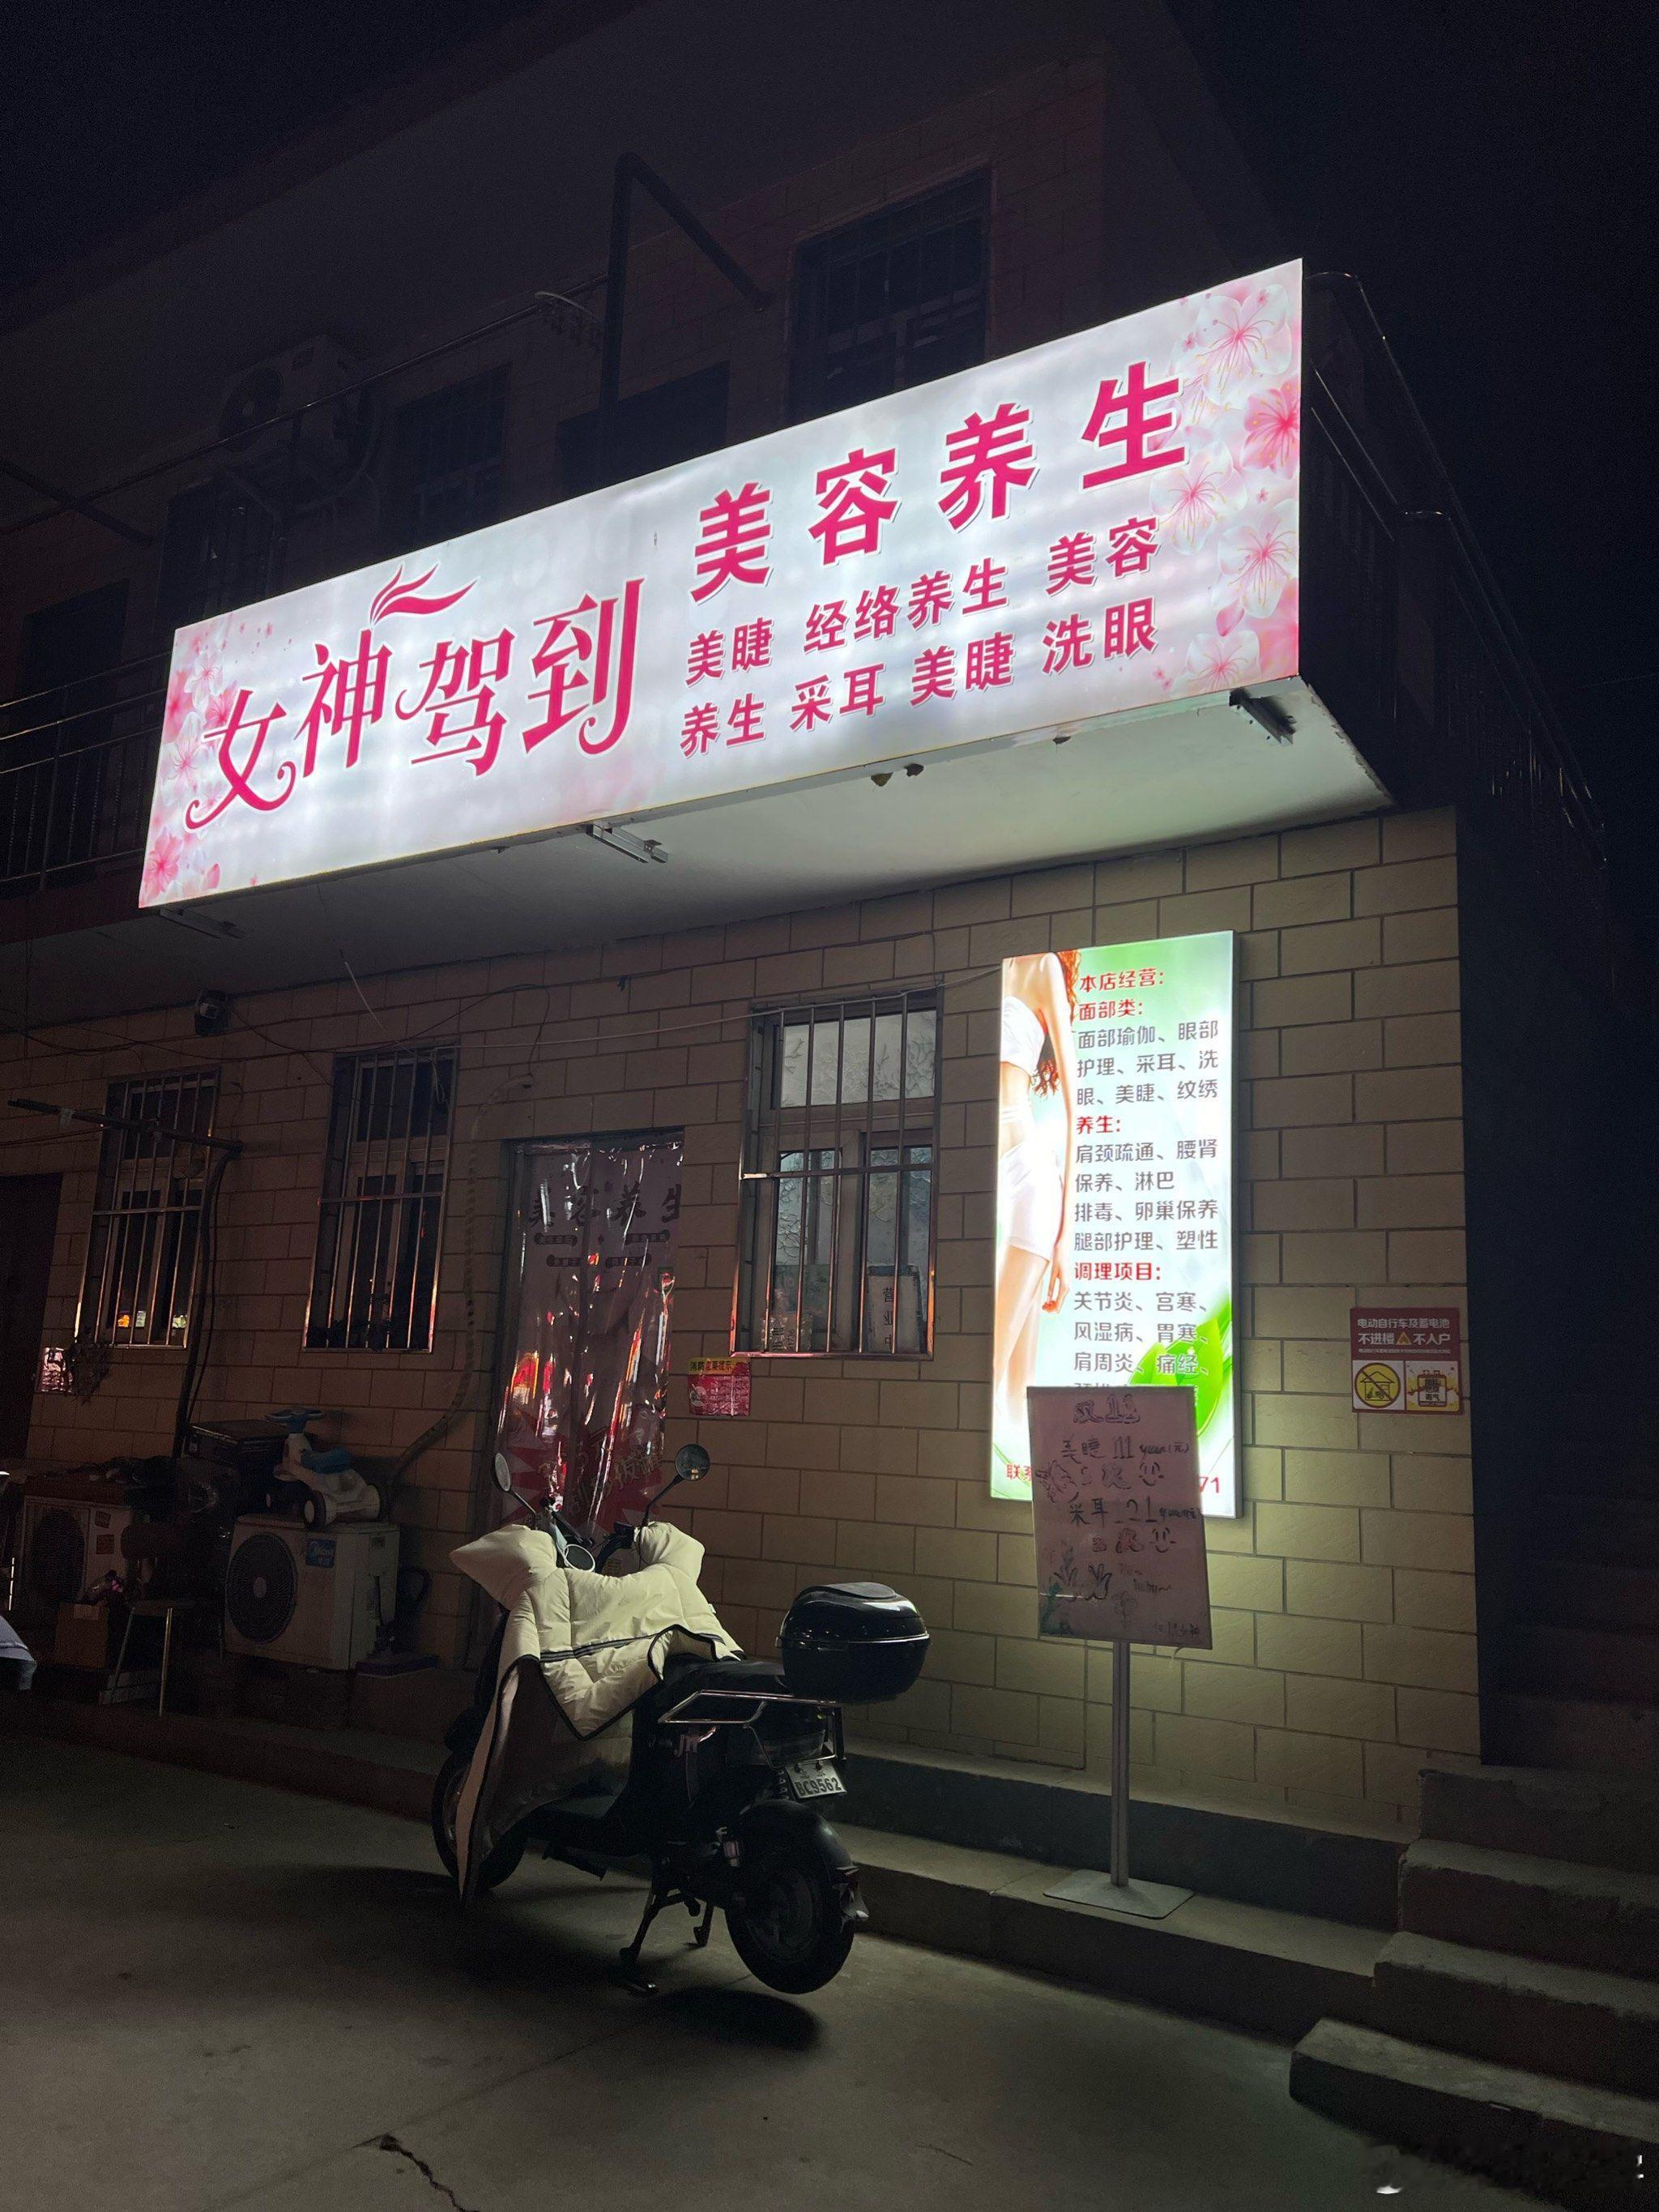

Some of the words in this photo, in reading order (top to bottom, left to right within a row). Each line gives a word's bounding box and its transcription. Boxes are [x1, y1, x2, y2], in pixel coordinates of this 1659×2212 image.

[690, 361, 1186, 603] 美容养生
[687, 618, 774, 686] 美睫
[804, 558, 1009, 654] 经络养生
[1047, 517, 1159, 596] 美容
[681, 694, 765, 758] 养生
[791, 663, 885, 732] 采耳
[911, 631, 1015, 706] 美睫
[1043, 597, 1157, 676] 洗眼
[185, 579, 645, 831] 女神驾到
[1080, 967, 1165, 993] 本店经营：
[1078, 998, 1143, 1022] 面部类：
[1076, 1115, 1120, 1135] 养生：
[1074, 1262, 1161, 1281] 调理项目：
[1357, 1318, 1450, 1329] 电动自行车及蓄电池
[1358, 1333, 1394, 1345] 不进楼
[795, 1777, 842, 1796] BC9562
